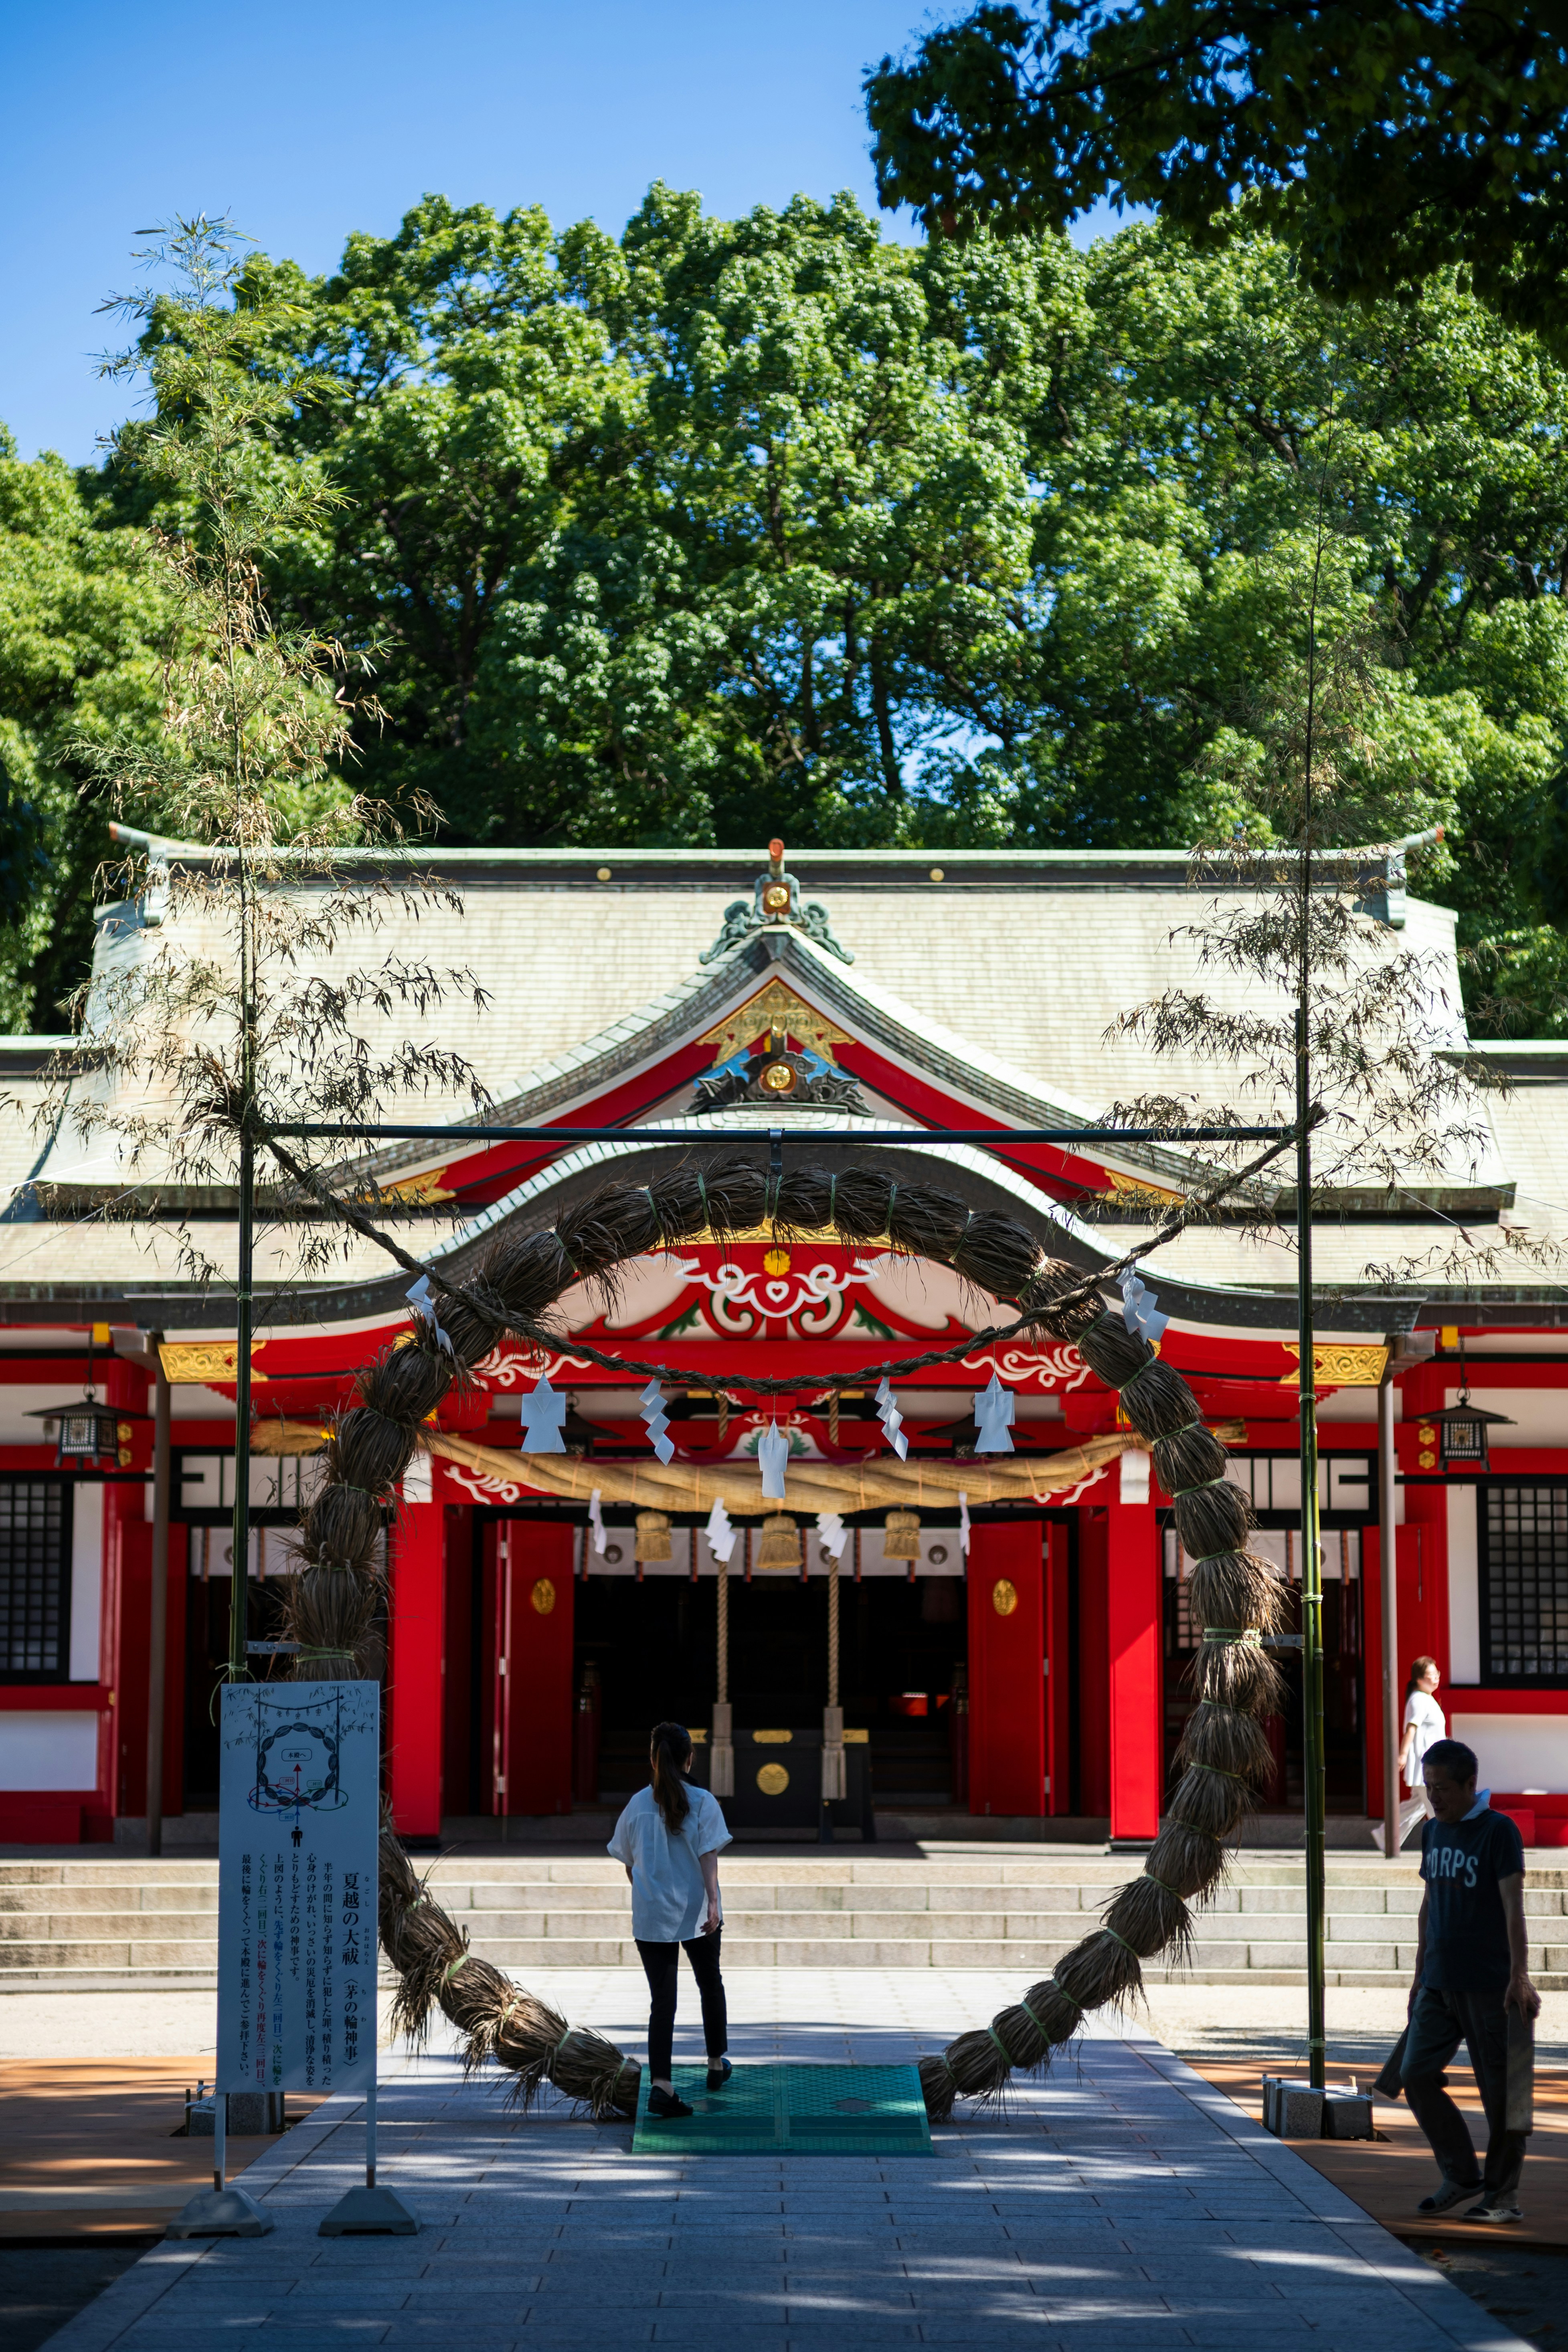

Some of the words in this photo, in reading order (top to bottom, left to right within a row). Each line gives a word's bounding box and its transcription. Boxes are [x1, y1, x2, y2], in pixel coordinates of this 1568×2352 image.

[290, 1853, 300, 1981] とりもどすための神事です。
[342, 1872, 360, 1966] 夏越の大祓
